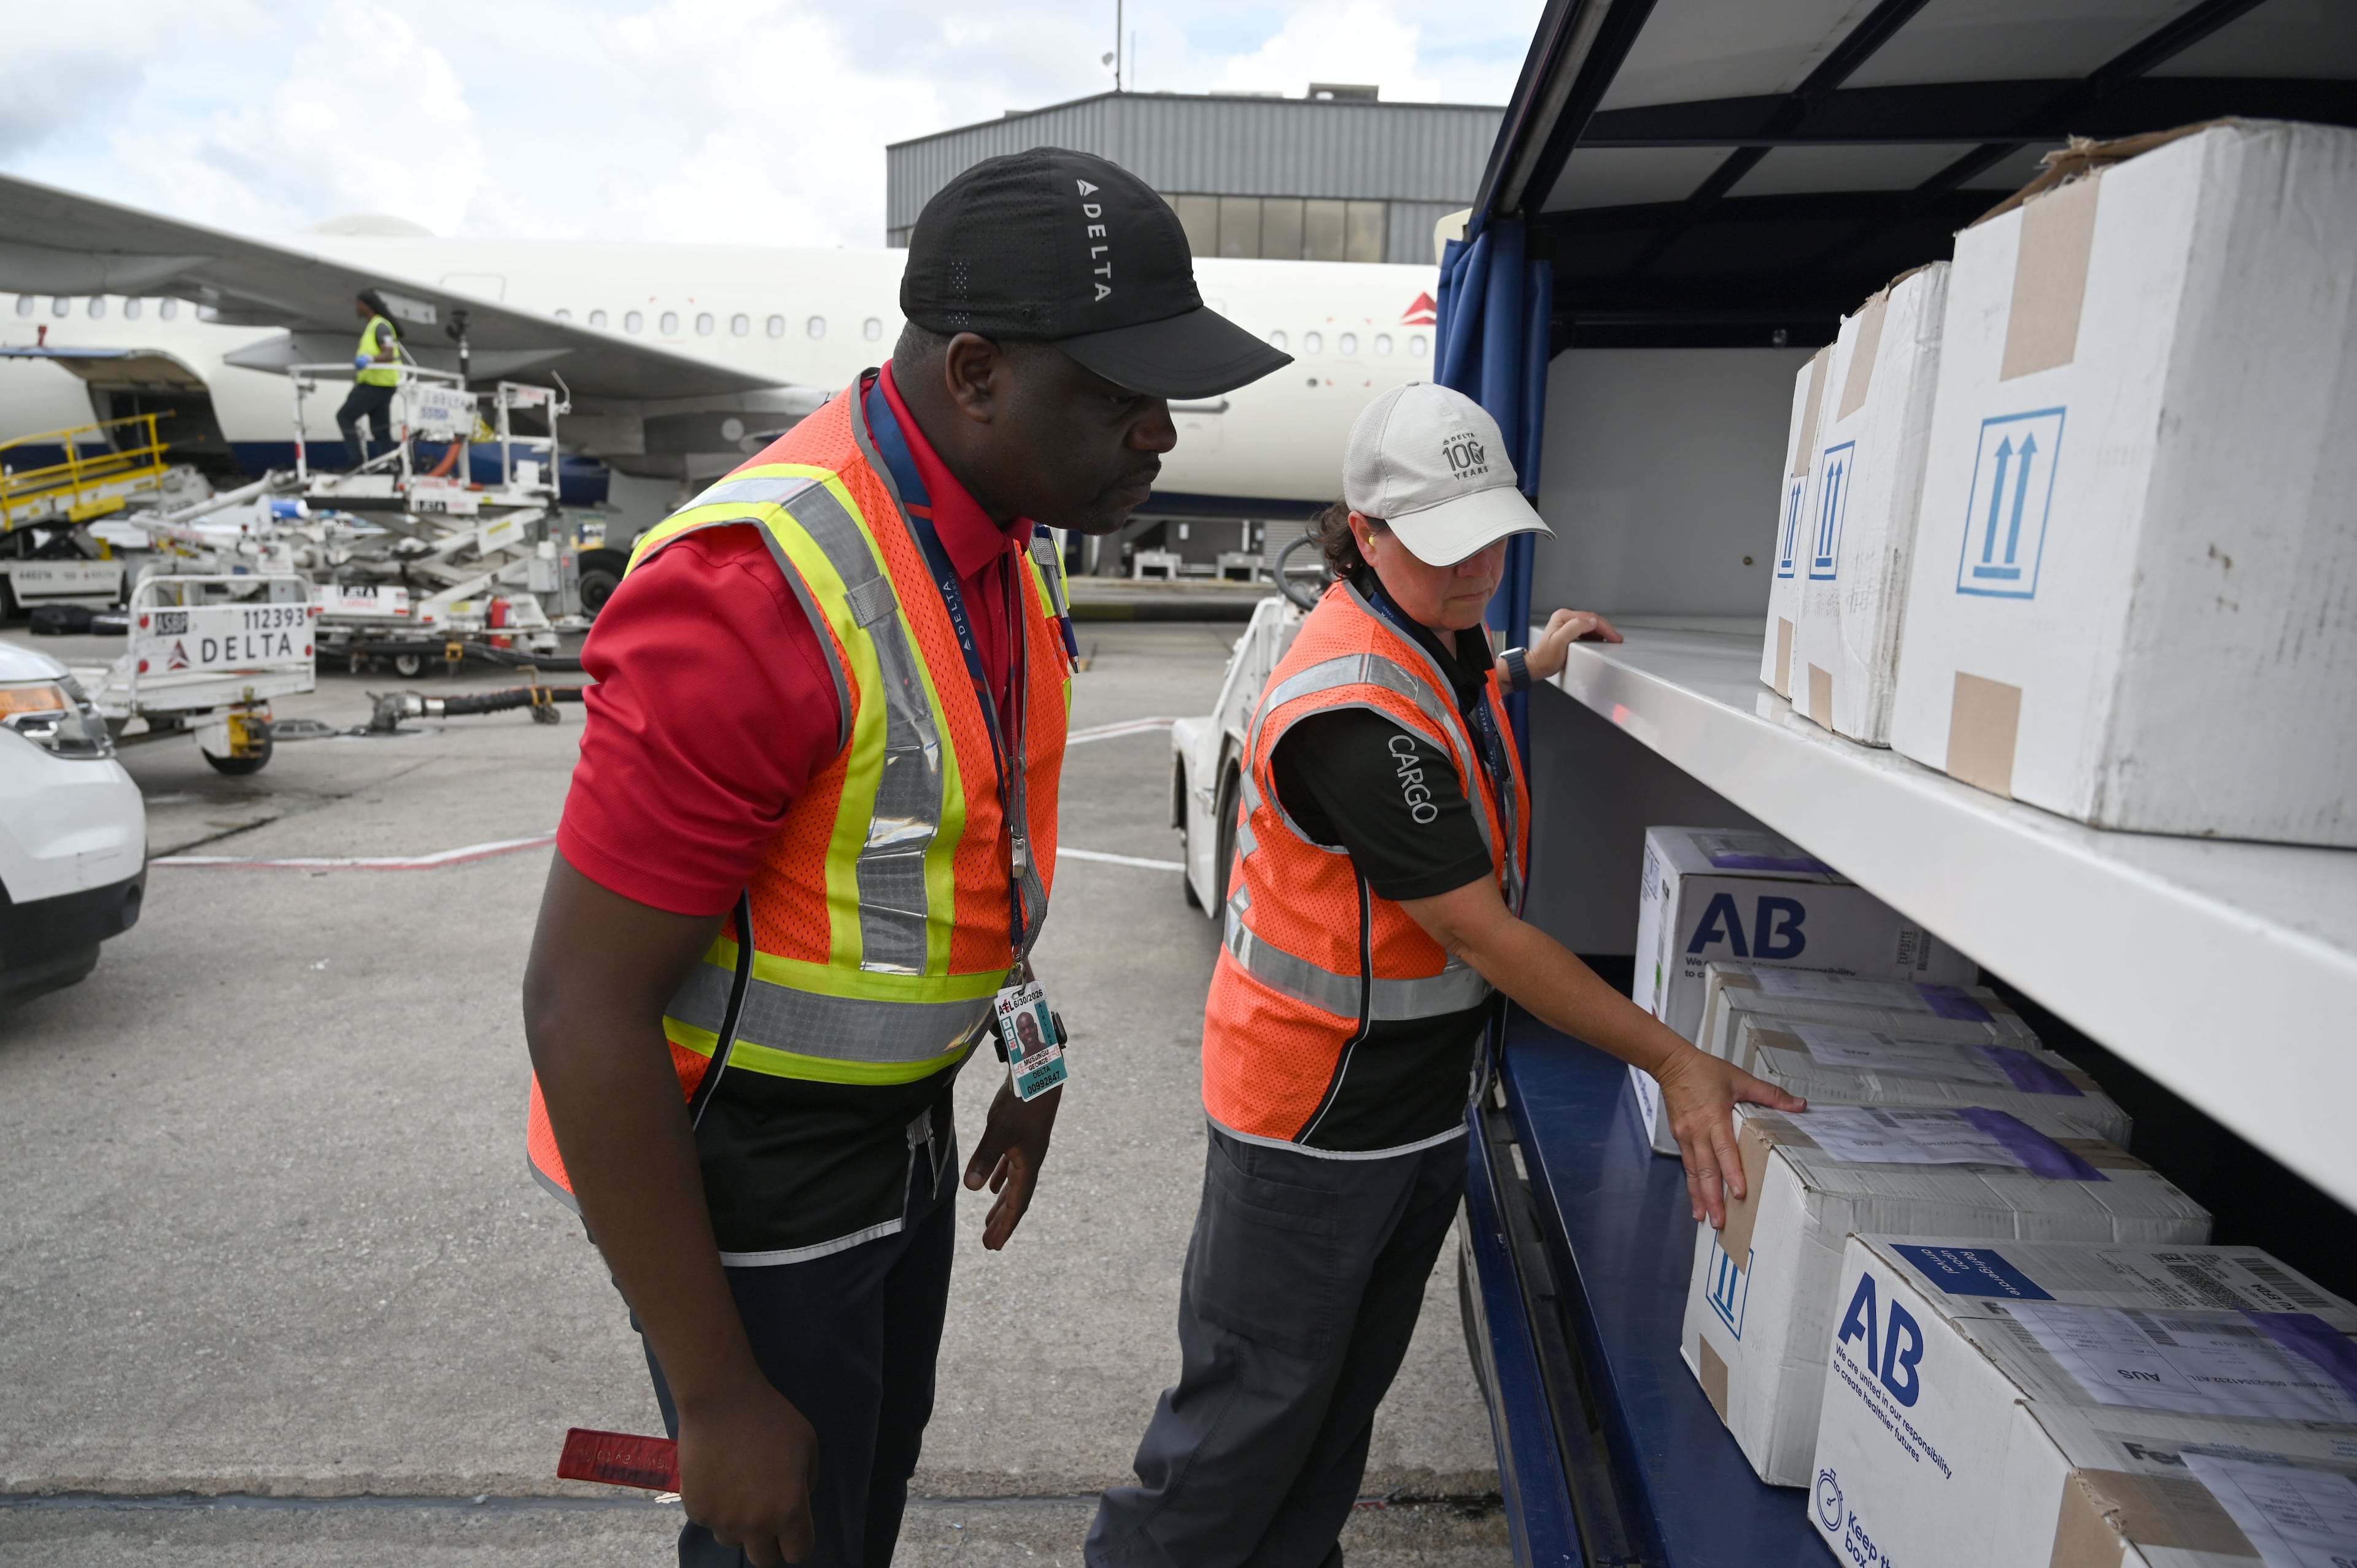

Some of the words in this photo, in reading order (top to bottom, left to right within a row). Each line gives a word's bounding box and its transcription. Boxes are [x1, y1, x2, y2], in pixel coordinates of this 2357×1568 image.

[1083, 204, 1112, 302] DELTA
[1451, 433, 1475, 442] DELTA
[1454, 466, 1488, 480] YEARS
[948, 572, 961, 602] CARGO
[243, 607, 305, 630] 112393
[943, 582, 966, 636] DELTA
[202, 632, 292, 664] DELTA
[1479, 706, 1488, 732] DELTA
[1388, 735, 1438, 824] CARGO
[1686, 892, 1806, 960] AB
[1686, 957, 1701, 966] We
[1013, 989, 1043, 1008] 6/30/2026
[1028, 1057, 1049, 1071] GEORGE
[1032, 1065, 1051, 1079] DELTA
[1027, 1070, 1061, 1095] 00992847
[1921, 1248, 1960, 1274] arrival
[1940, 1249, 1970, 1270] upon
[1960, 1251, 2021, 1296] Refrigerate
[1837, 1271, 1924, 1408] AB
[2117, 1369, 2161, 1383] AUS
[1833, 1360, 1840, 1372] to
[1841, 1370, 1862, 1397] create
[1864, 1391, 1894, 1432] healthier
[1895, 1427, 1919, 1462] futures
[1836, 1343, 1846, 1361] We
[1848, 1358, 1858, 1374] are
[1859, 1370, 1881, 1400] united
[1882, 1393, 1889, 1408] in
[1889, 1405, 1902, 1421] our
[1902, 1418, 1952, 1480] responsibility
[1848, 1510, 1877, 1561] Keep
